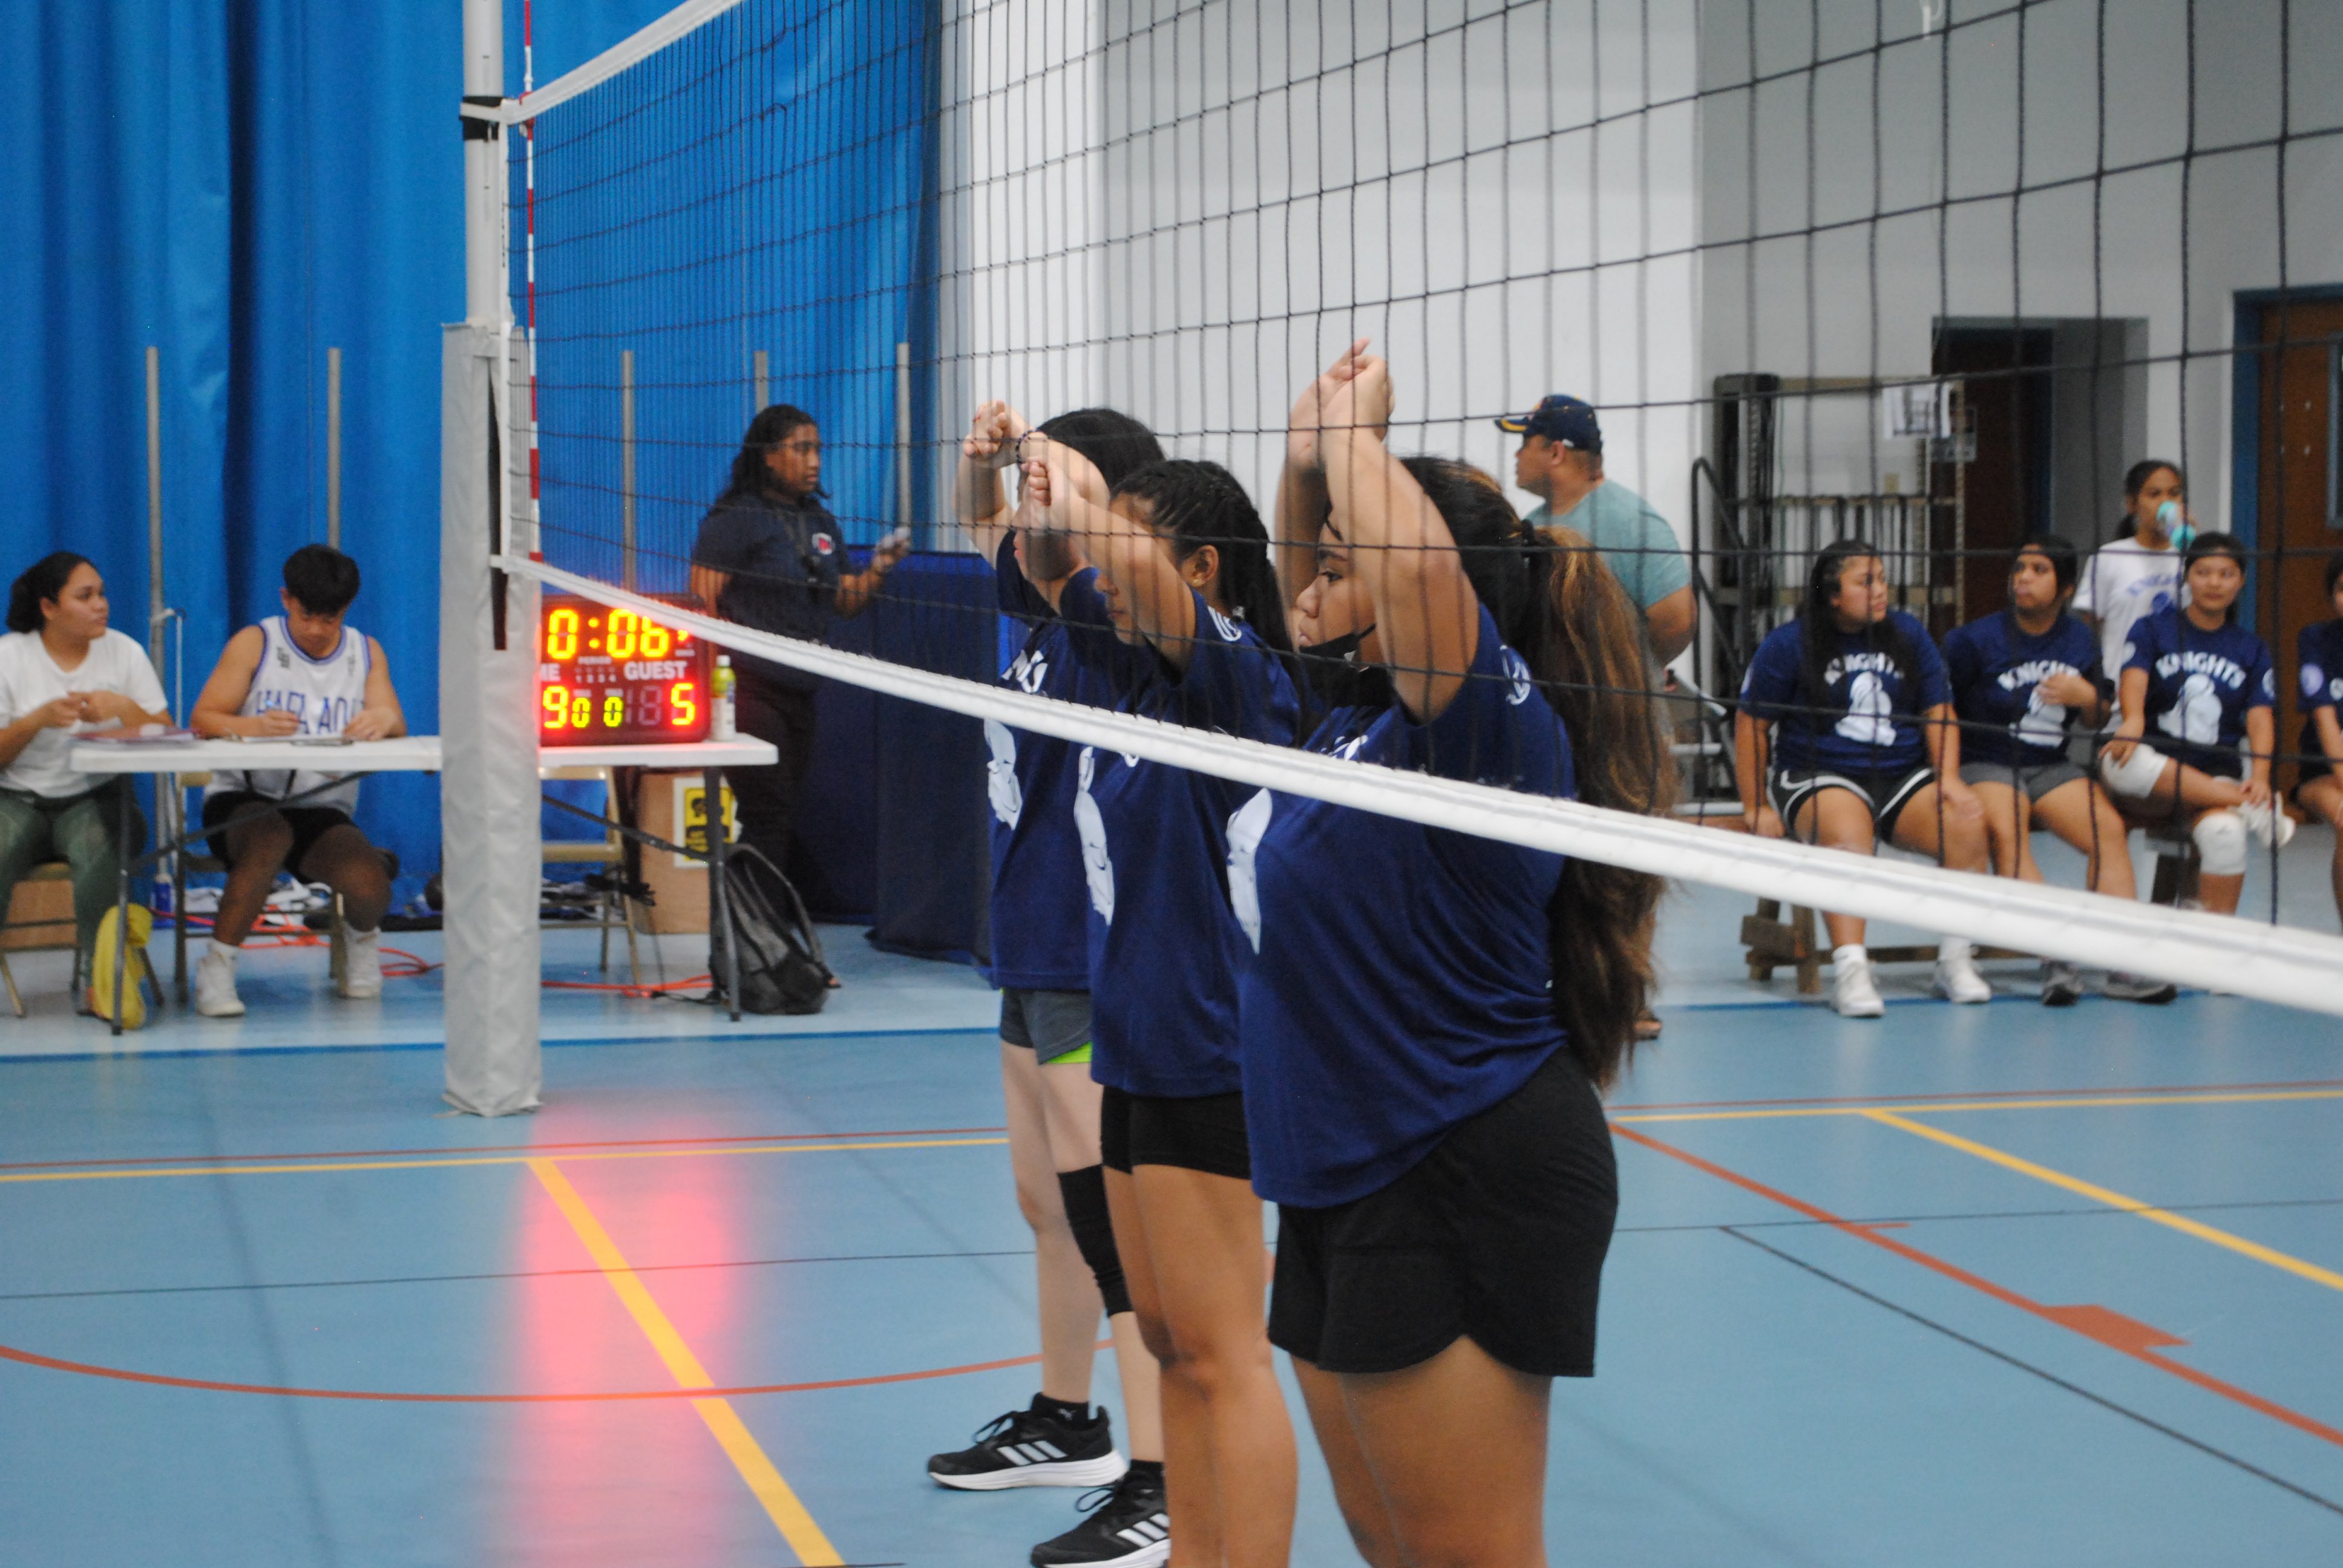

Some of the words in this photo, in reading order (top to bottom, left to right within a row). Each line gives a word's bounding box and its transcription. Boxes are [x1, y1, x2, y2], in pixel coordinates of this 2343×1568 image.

[623, 661, 688, 681] GUEST
[2155, 650, 2246, 691] KNIGHTS
[670, 682, 695, 726] 5
